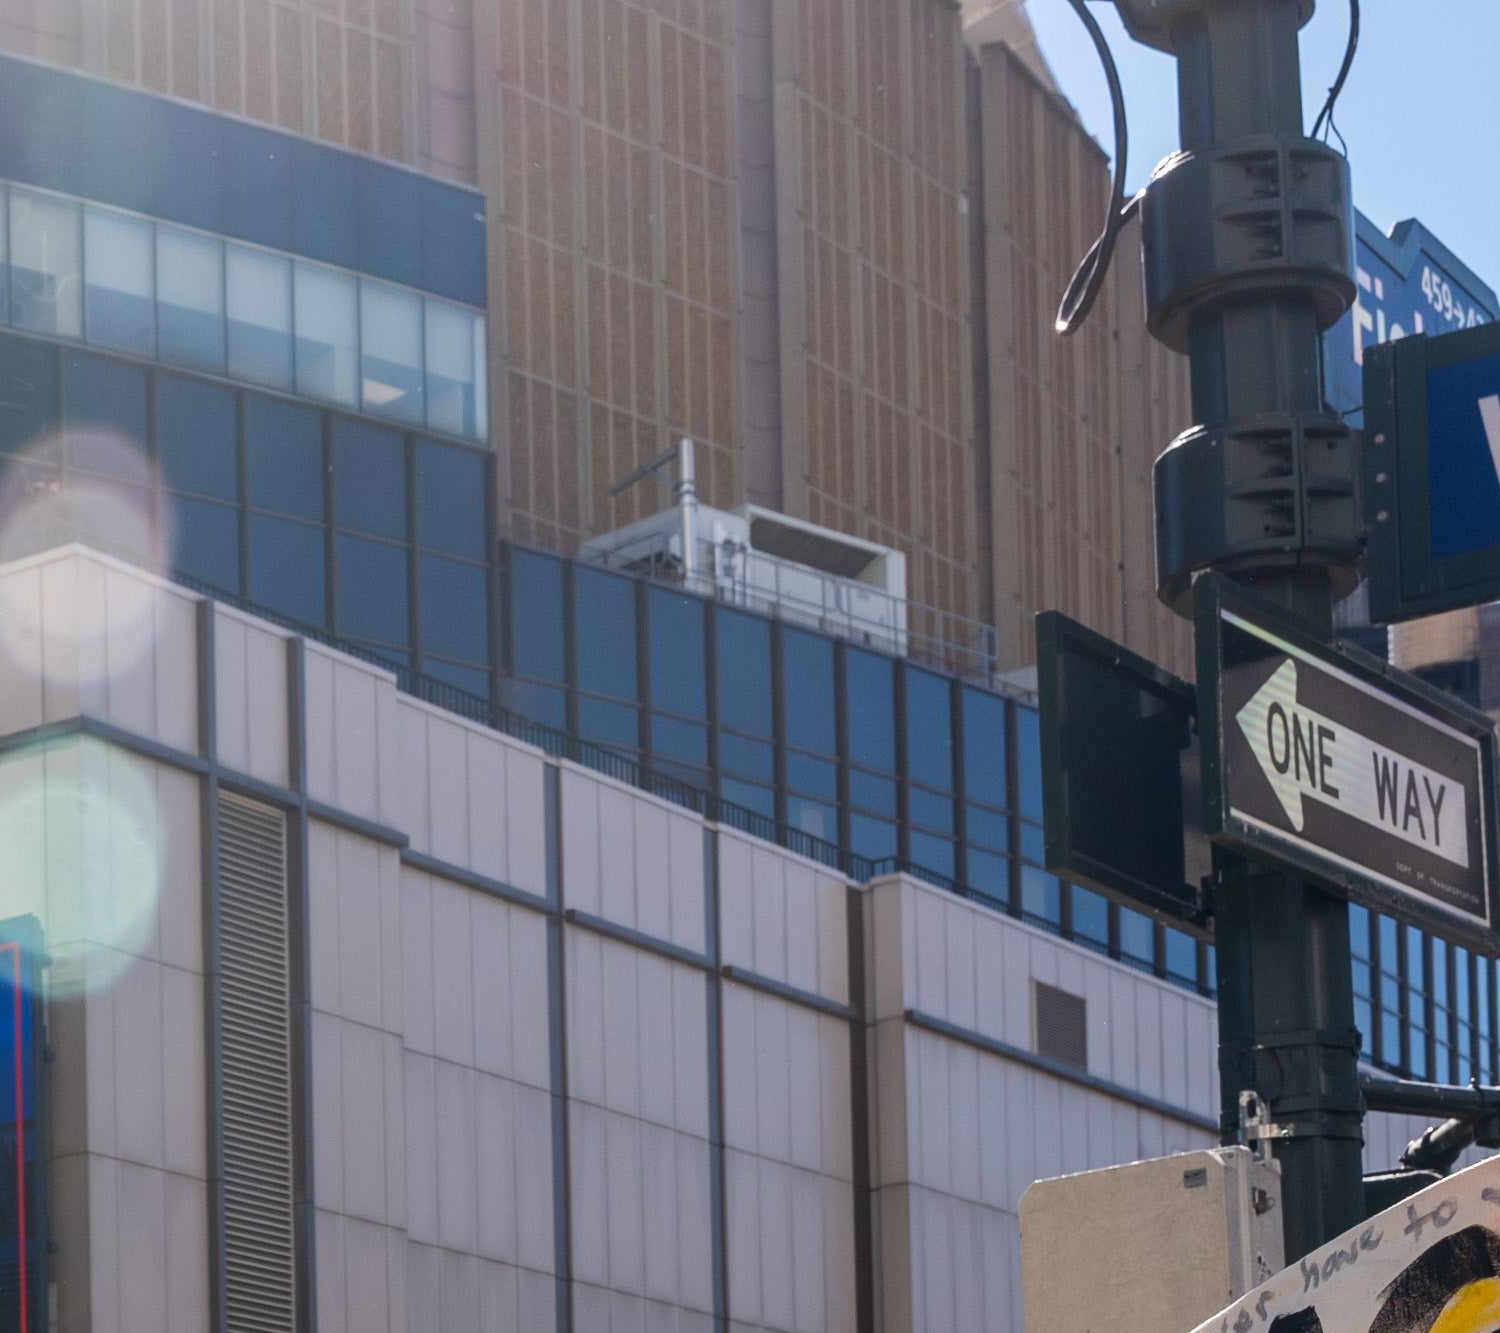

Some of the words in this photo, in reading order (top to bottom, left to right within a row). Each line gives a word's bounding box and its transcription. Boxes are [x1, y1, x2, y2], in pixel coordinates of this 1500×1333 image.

[1266, 700, 1341, 803] ONE
[1372, 750, 1449, 850] WAY
[1299, 1224, 1384, 1293] have
[1404, 1200, 1458, 1243] to
